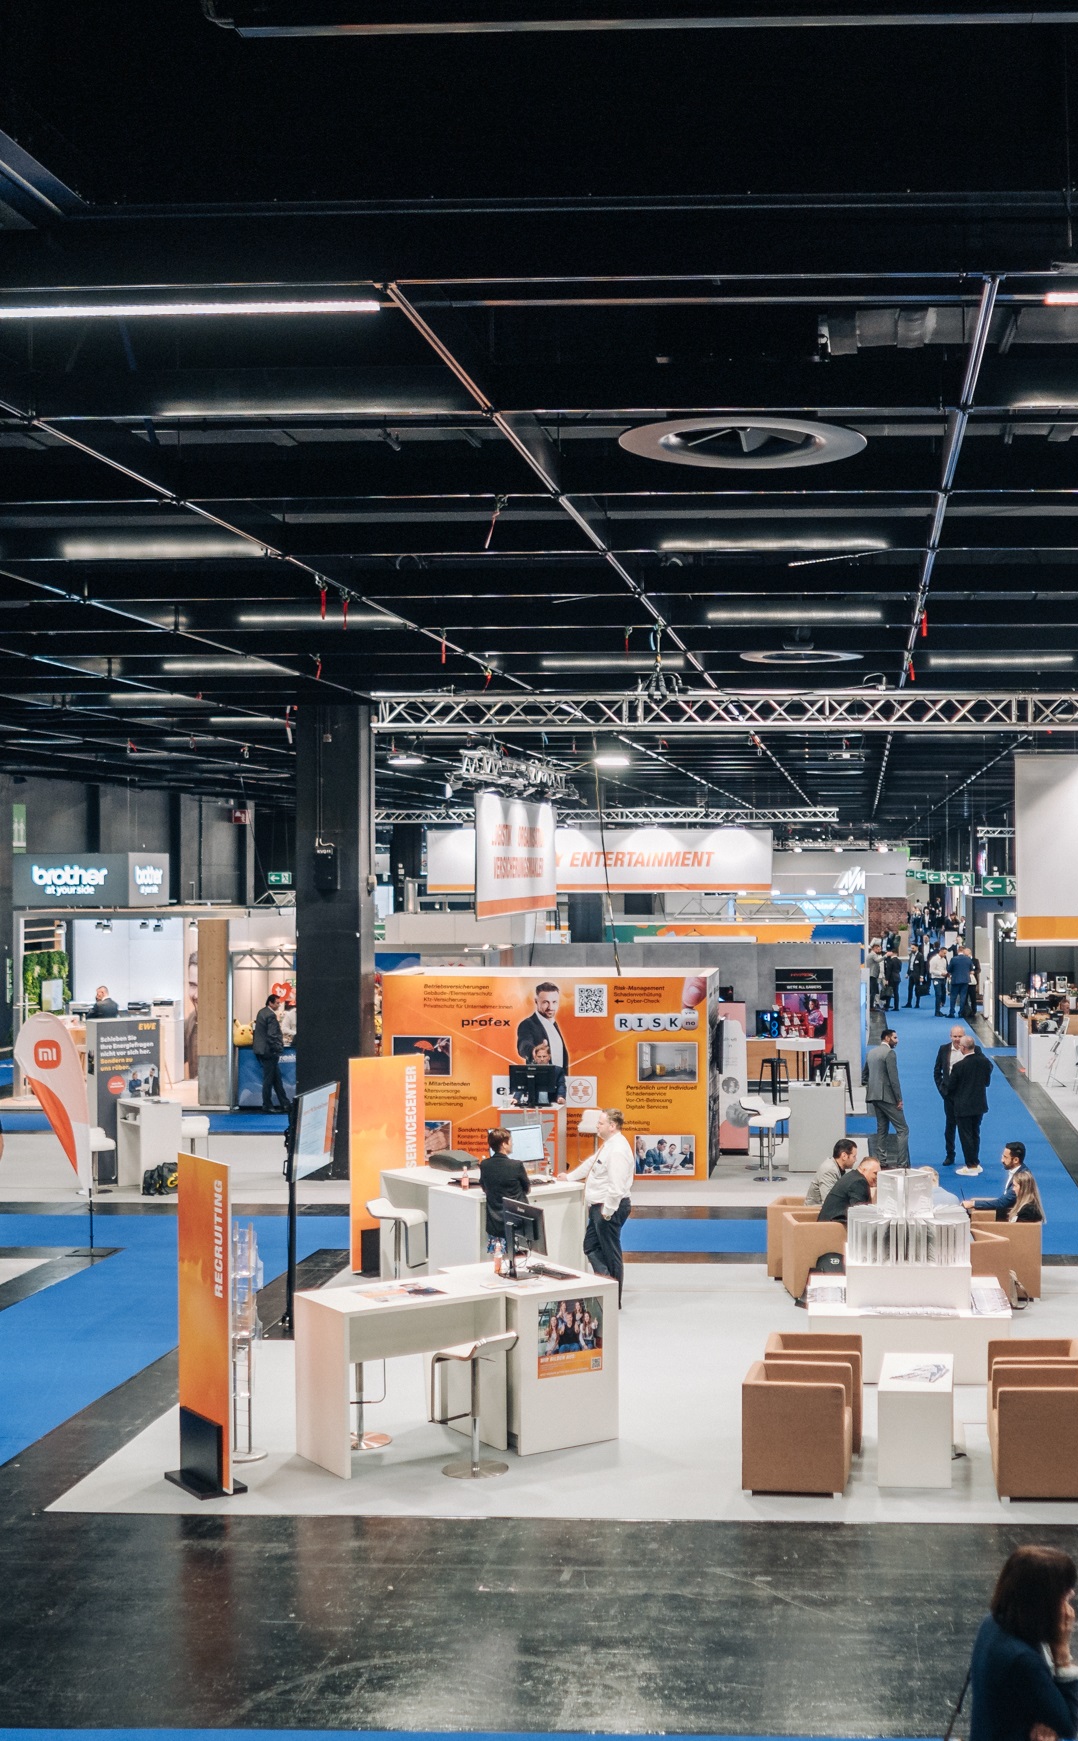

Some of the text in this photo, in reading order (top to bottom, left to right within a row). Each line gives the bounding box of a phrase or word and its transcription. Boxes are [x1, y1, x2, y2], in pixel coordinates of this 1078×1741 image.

[569, 851, 716, 868] ENTERTAINMENT
[31, 864, 108, 885] brother
[45, 885, 95, 896] at your side
[138, 1022, 157, 1031] EWE
[461, 1017, 511, 1028] profex
[619, 1018, 679, 1028] RISK
[113, 1042, 154, 1050] Energiefragen
[405, 1065, 417, 1168] SERVICECENTER
[213, 1180, 224, 1299] RECRUITING
